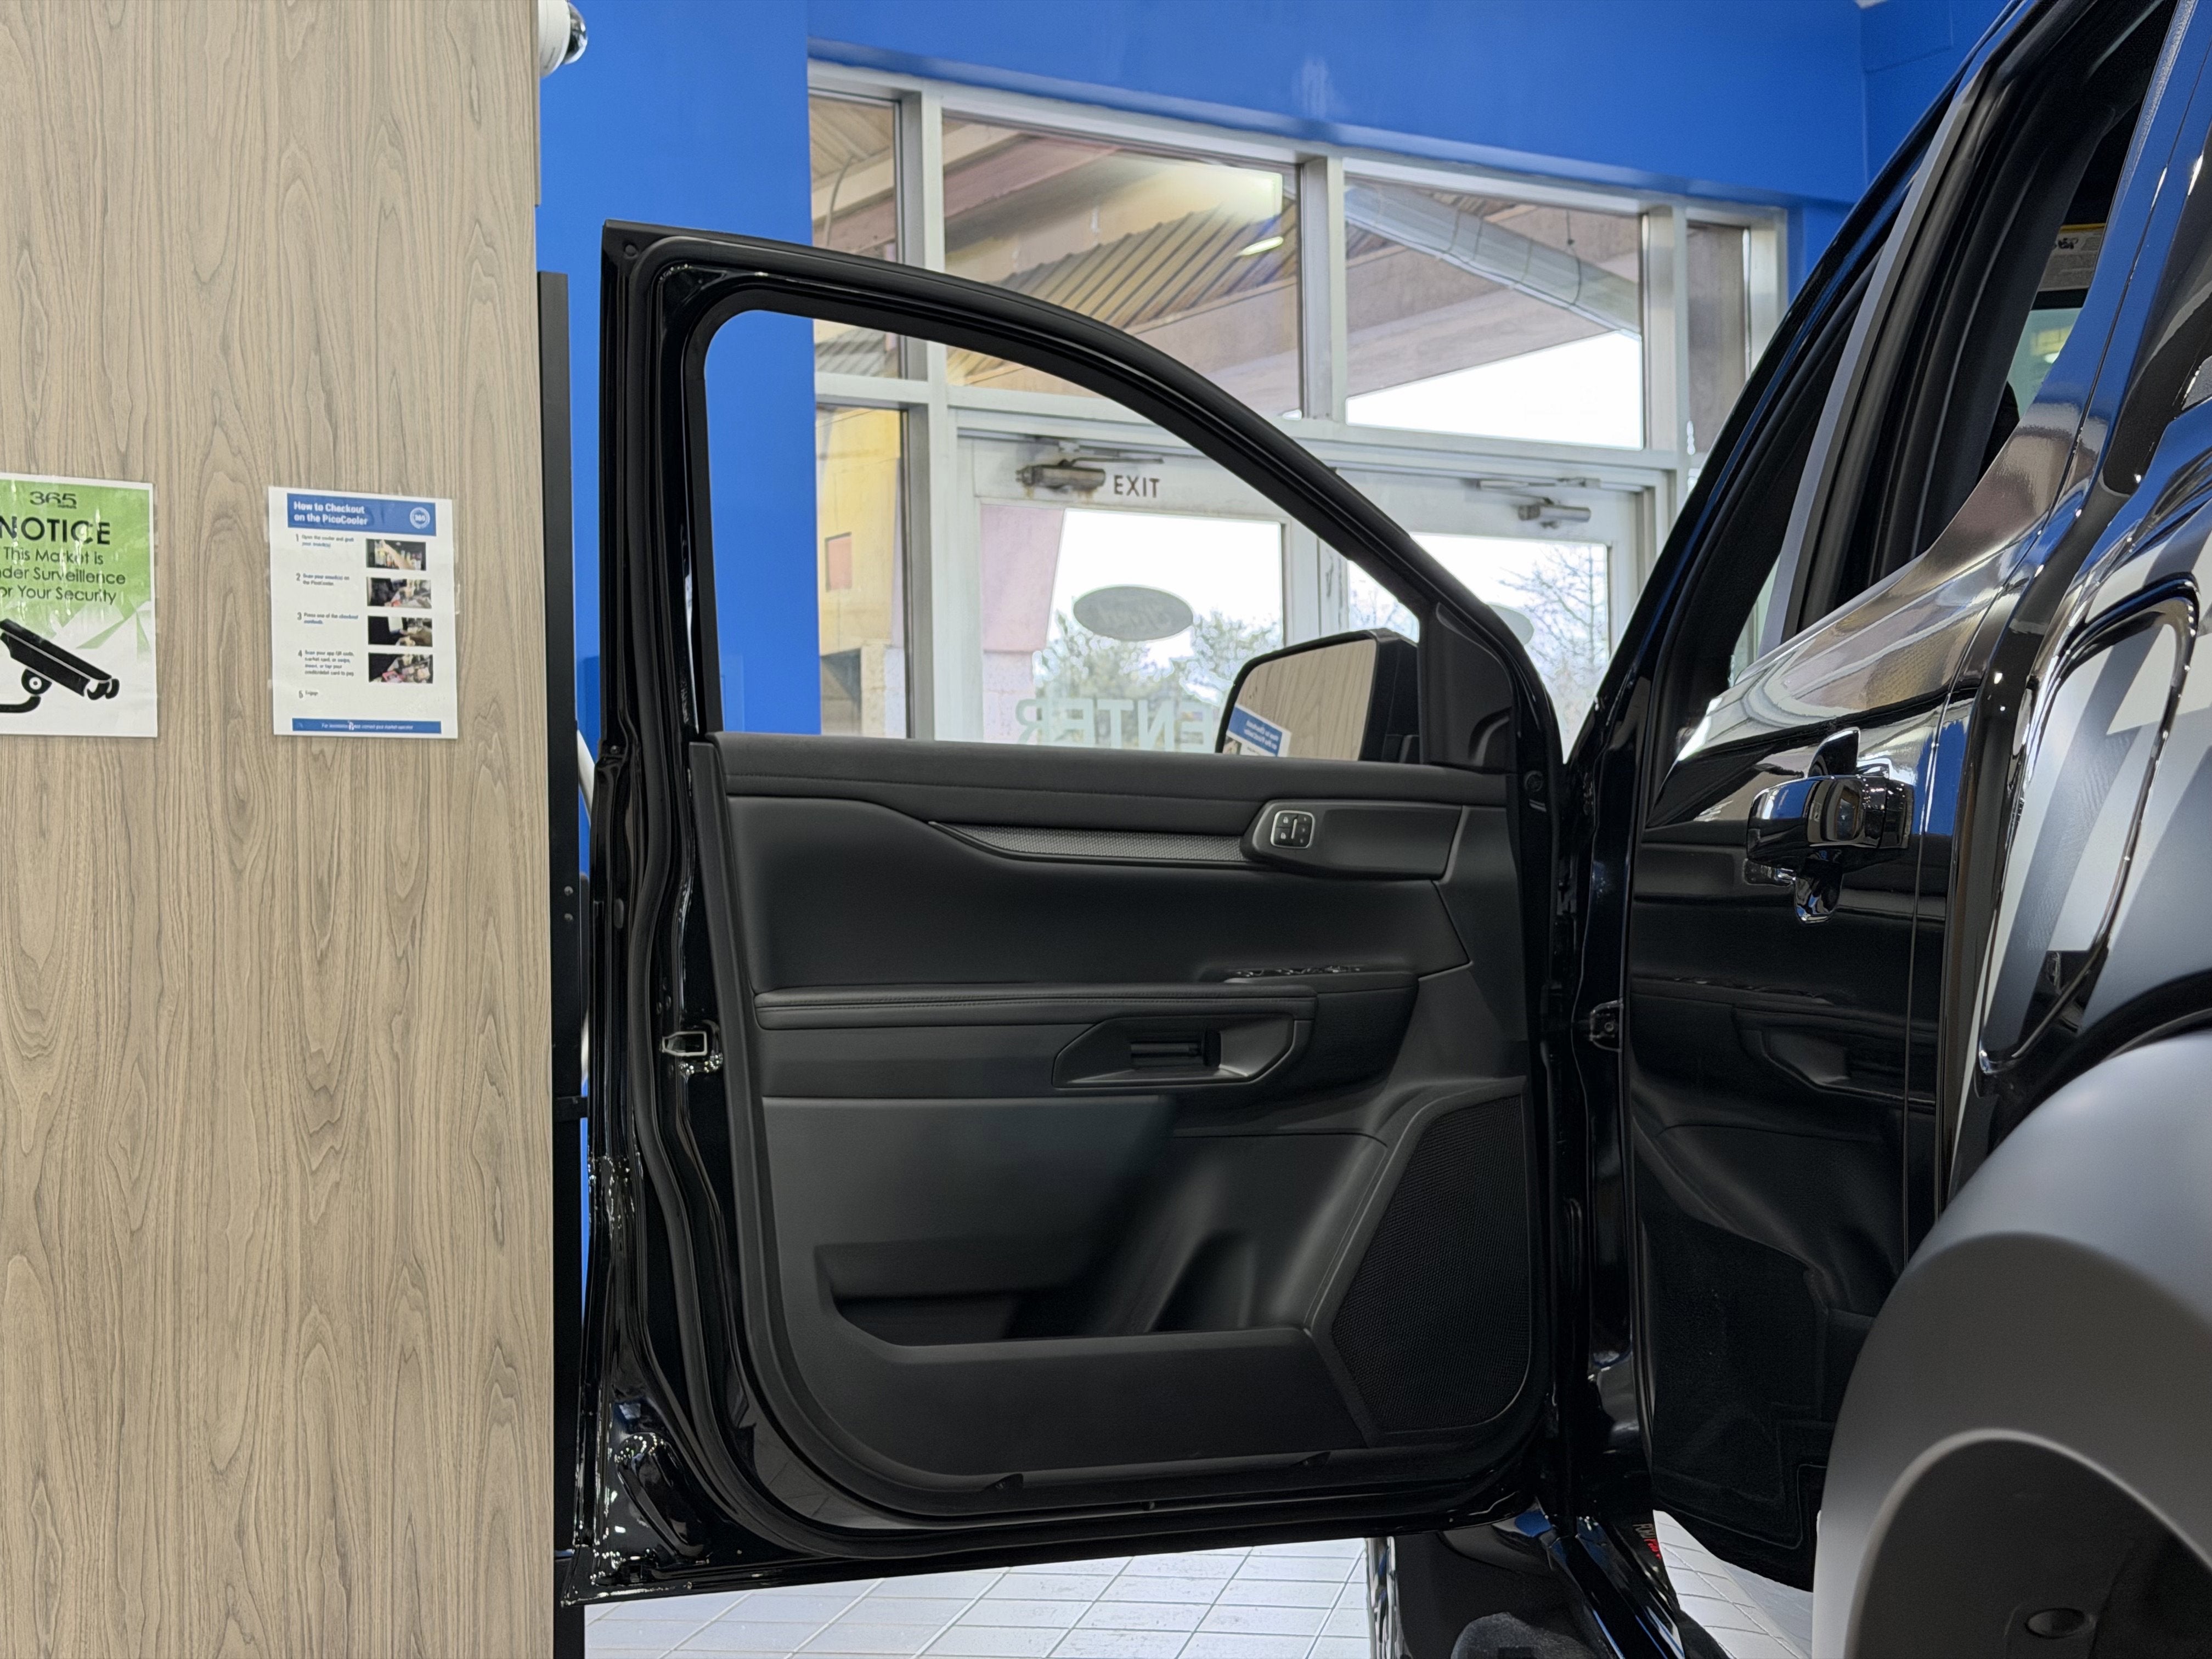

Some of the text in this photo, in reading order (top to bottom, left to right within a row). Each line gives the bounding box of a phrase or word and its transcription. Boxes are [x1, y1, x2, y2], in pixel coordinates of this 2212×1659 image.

[1114, 475, 1160, 498] EXIT
[29, 491, 77, 506] 365
[294, 501, 365, 514] How to Checkout
[307, 513, 320, 523] the
[0, 515, 110, 545] NOTICE
[3, 546, 104, 565] This Maket is
[17, 585, 51, 599] Your
[55, 586, 117, 605] Security
